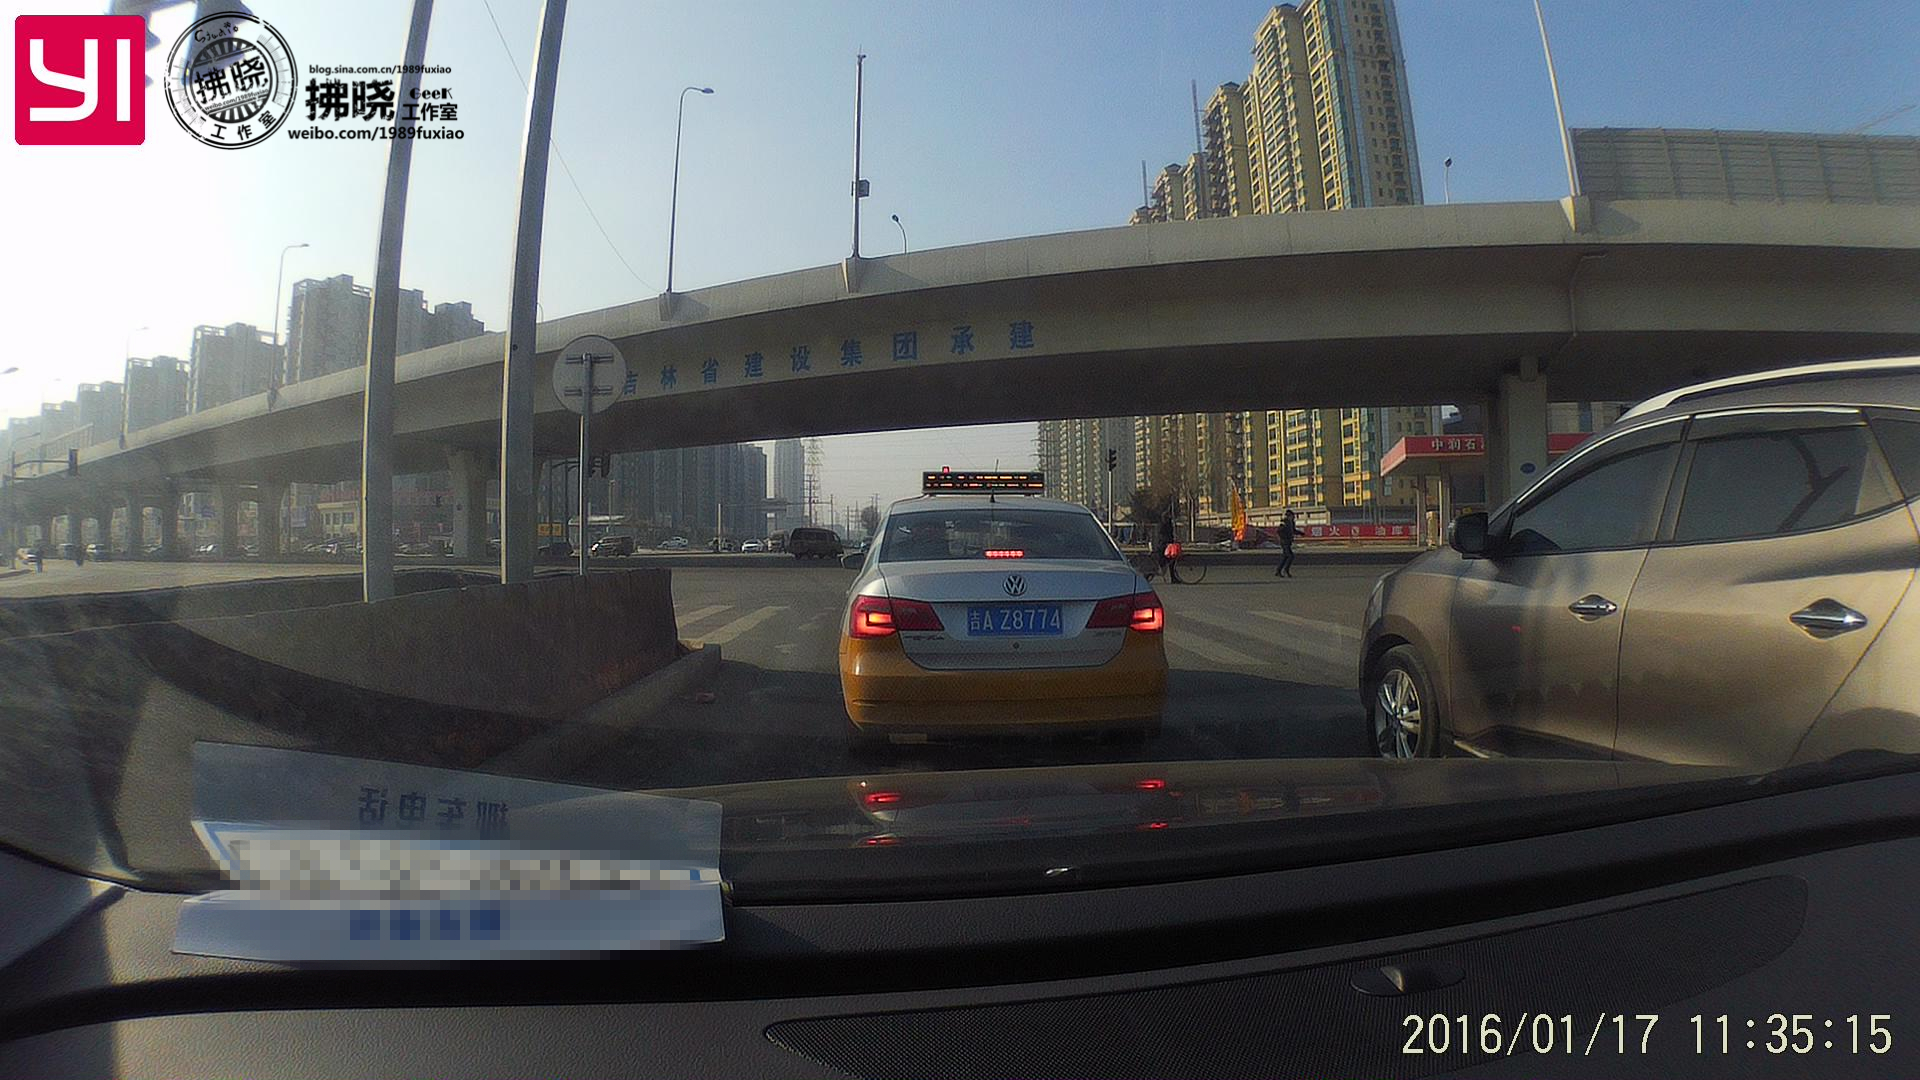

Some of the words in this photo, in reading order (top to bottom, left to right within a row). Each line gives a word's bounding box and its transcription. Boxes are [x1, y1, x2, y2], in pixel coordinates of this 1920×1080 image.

[623, 320, 1036, 396] 吉林省建设集团承建
[1001, 608, 1062, 631] Z8774
